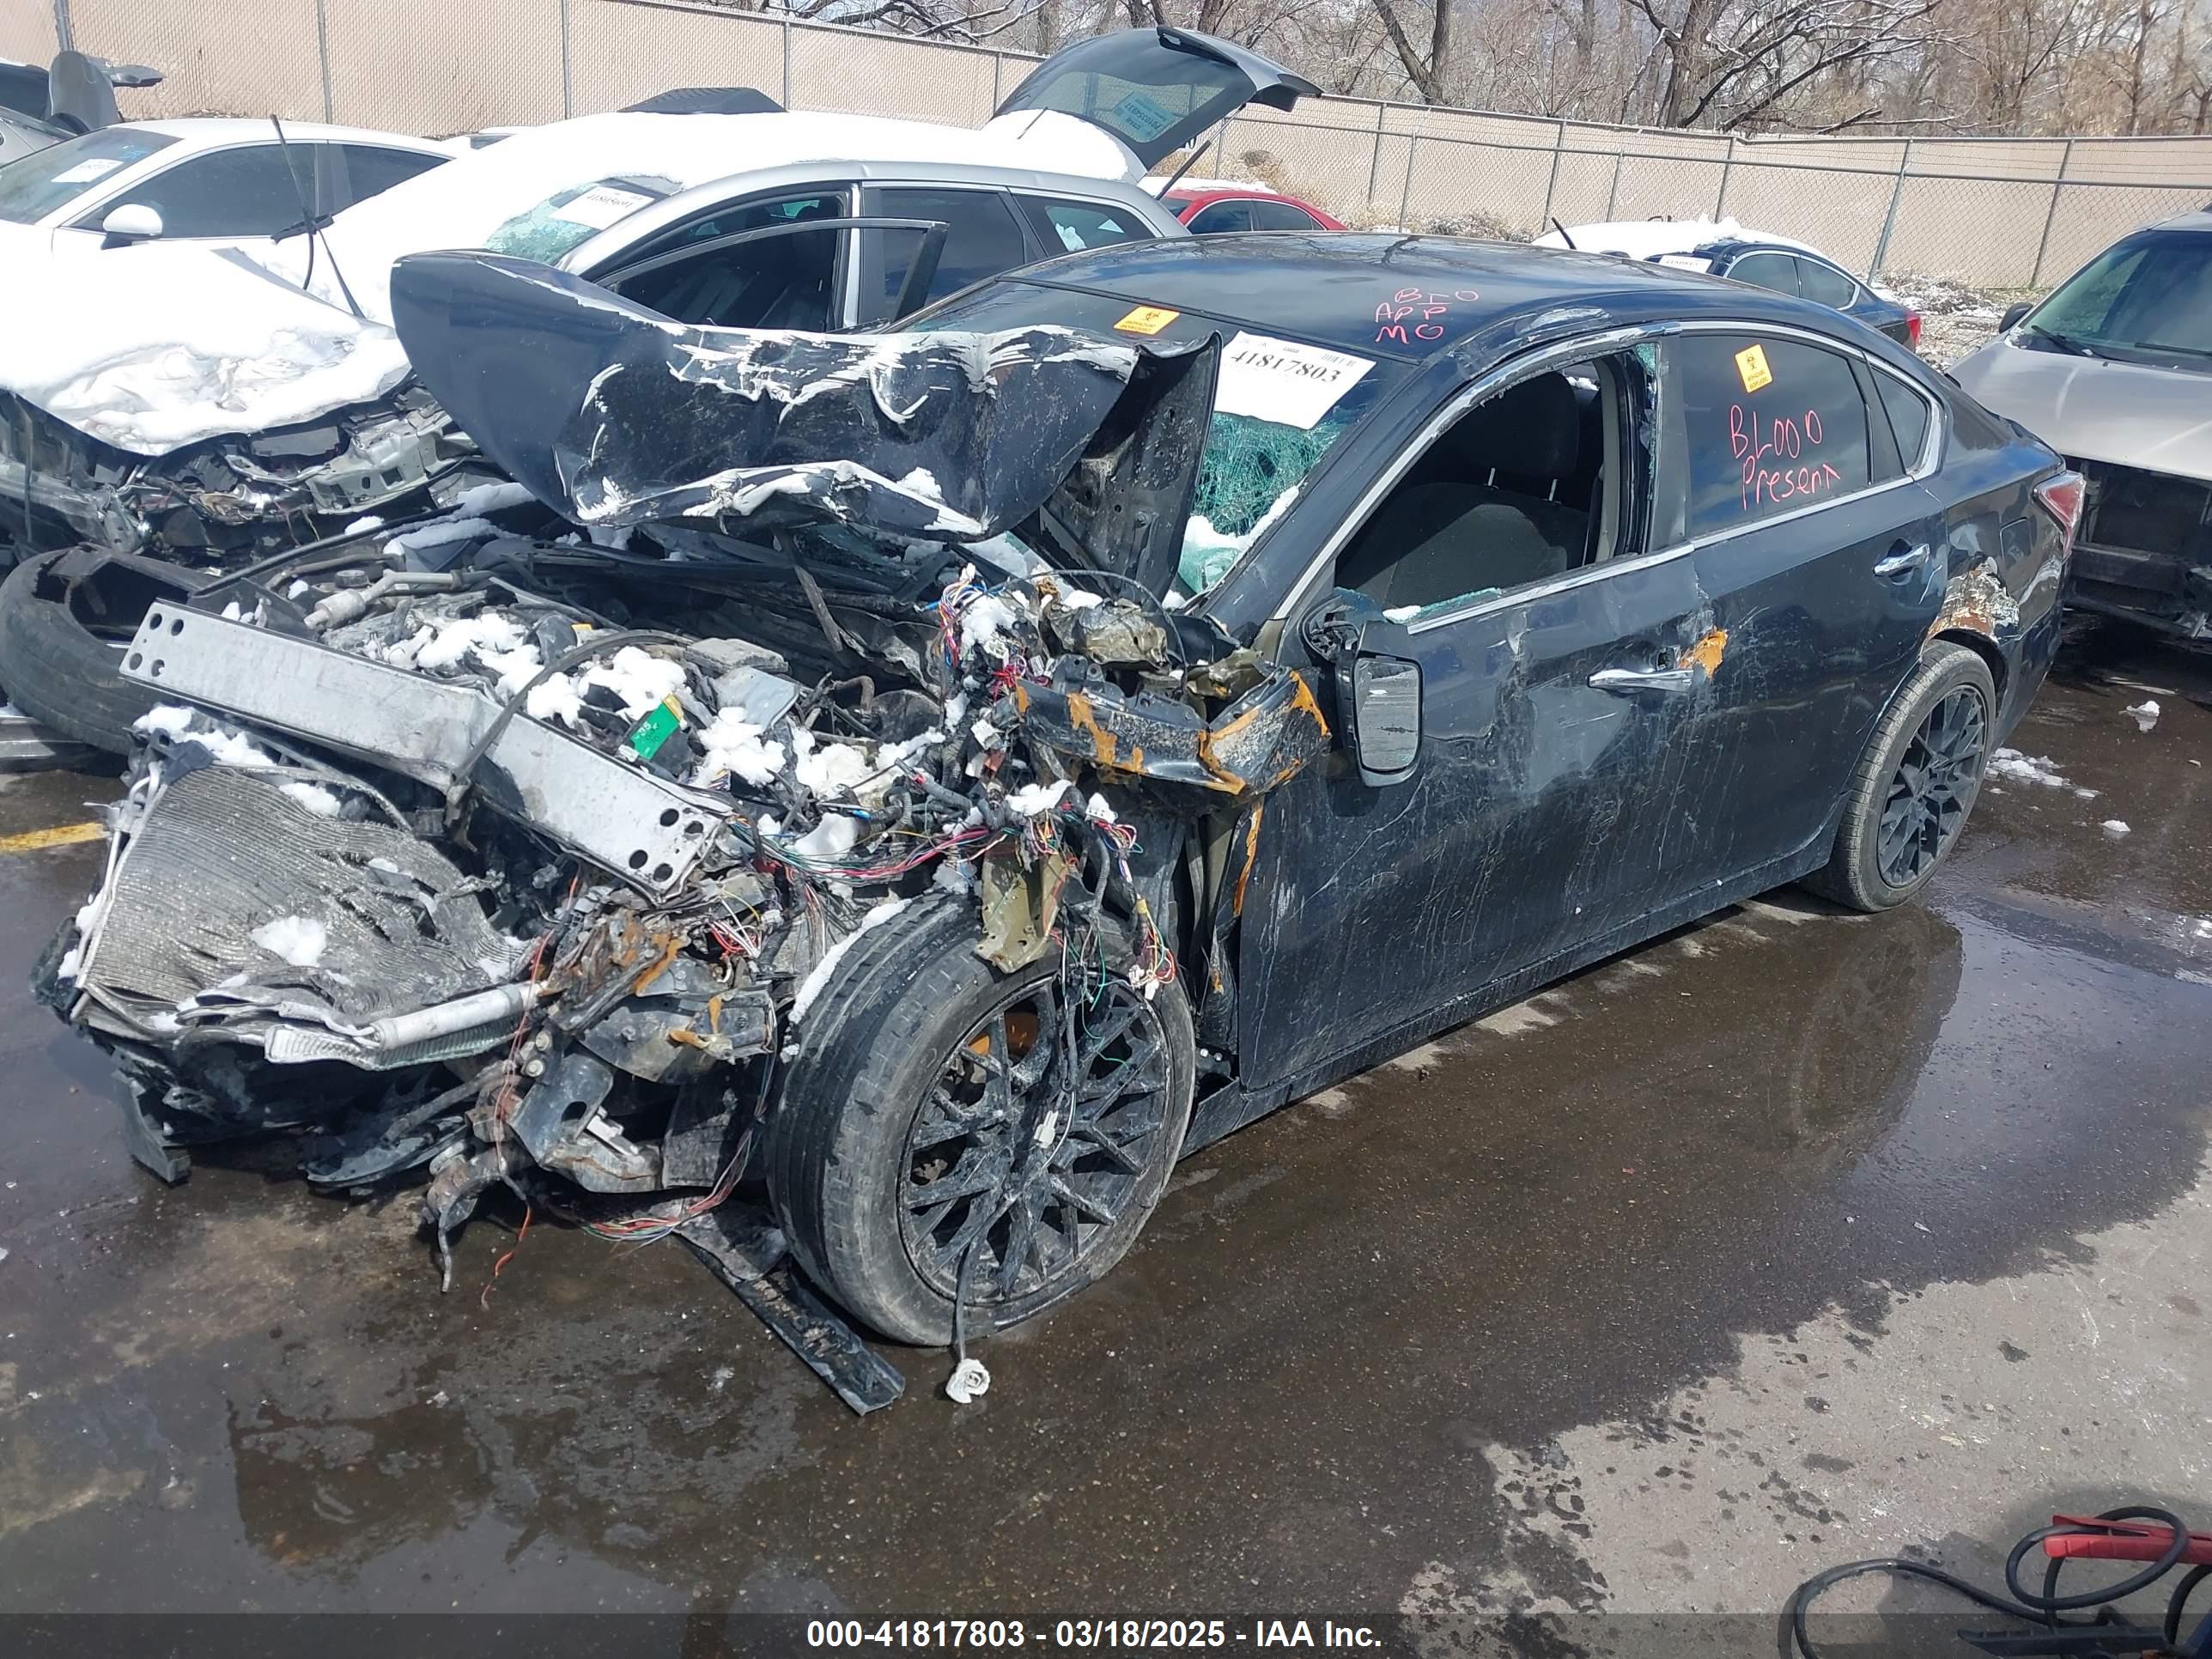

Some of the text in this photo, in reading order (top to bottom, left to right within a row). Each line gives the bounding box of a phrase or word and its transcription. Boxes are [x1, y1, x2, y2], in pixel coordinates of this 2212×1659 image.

[1395, 288, 1479, 304] BIO
[1231, 350, 1341, 382] 41817803
[1730, 404, 1823, 459] BLOOD
[1742, 455, 1841, 511] Present
